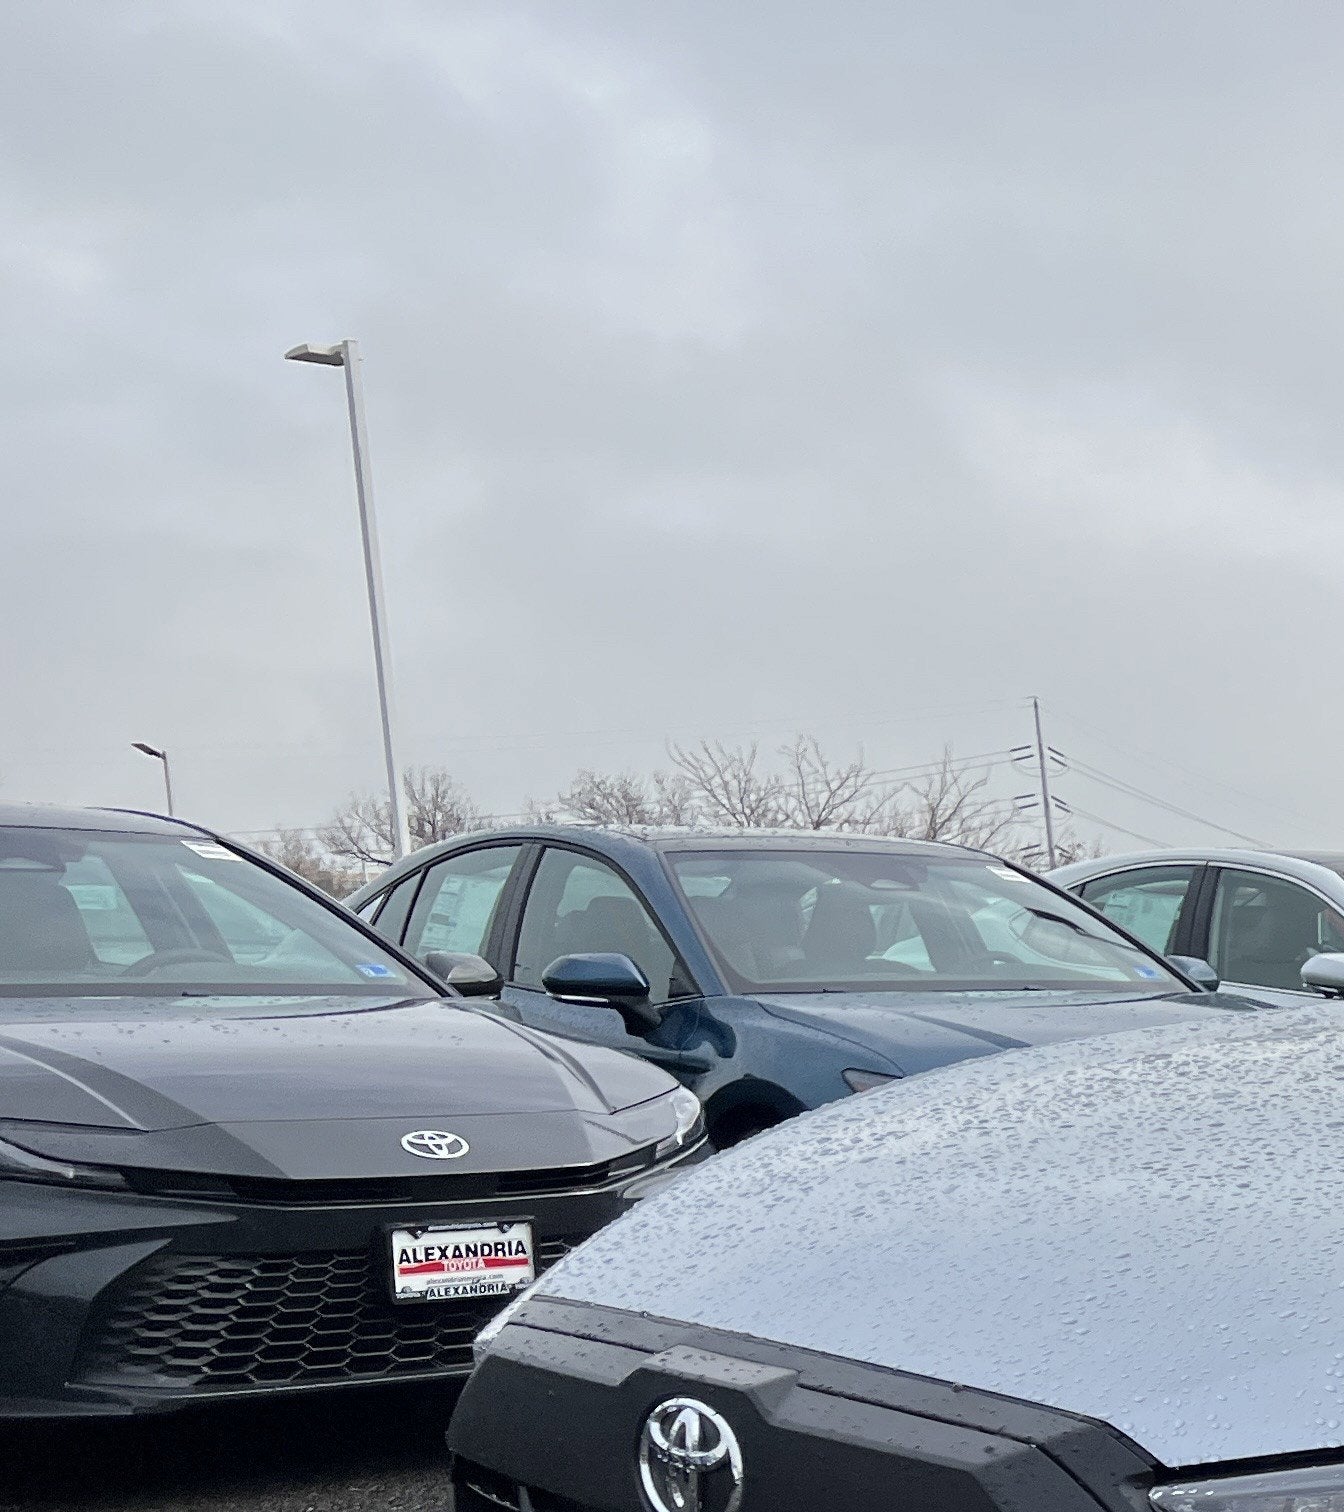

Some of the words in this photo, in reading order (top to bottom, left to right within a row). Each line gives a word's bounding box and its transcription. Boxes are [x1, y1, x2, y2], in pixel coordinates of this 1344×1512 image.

[399, 1240, 527, 1265] ALEXANDRIA
[443, 1257, 486, 1273] TOYOTA
[429, 1283, 507, 1298] ALEXANDRIA
